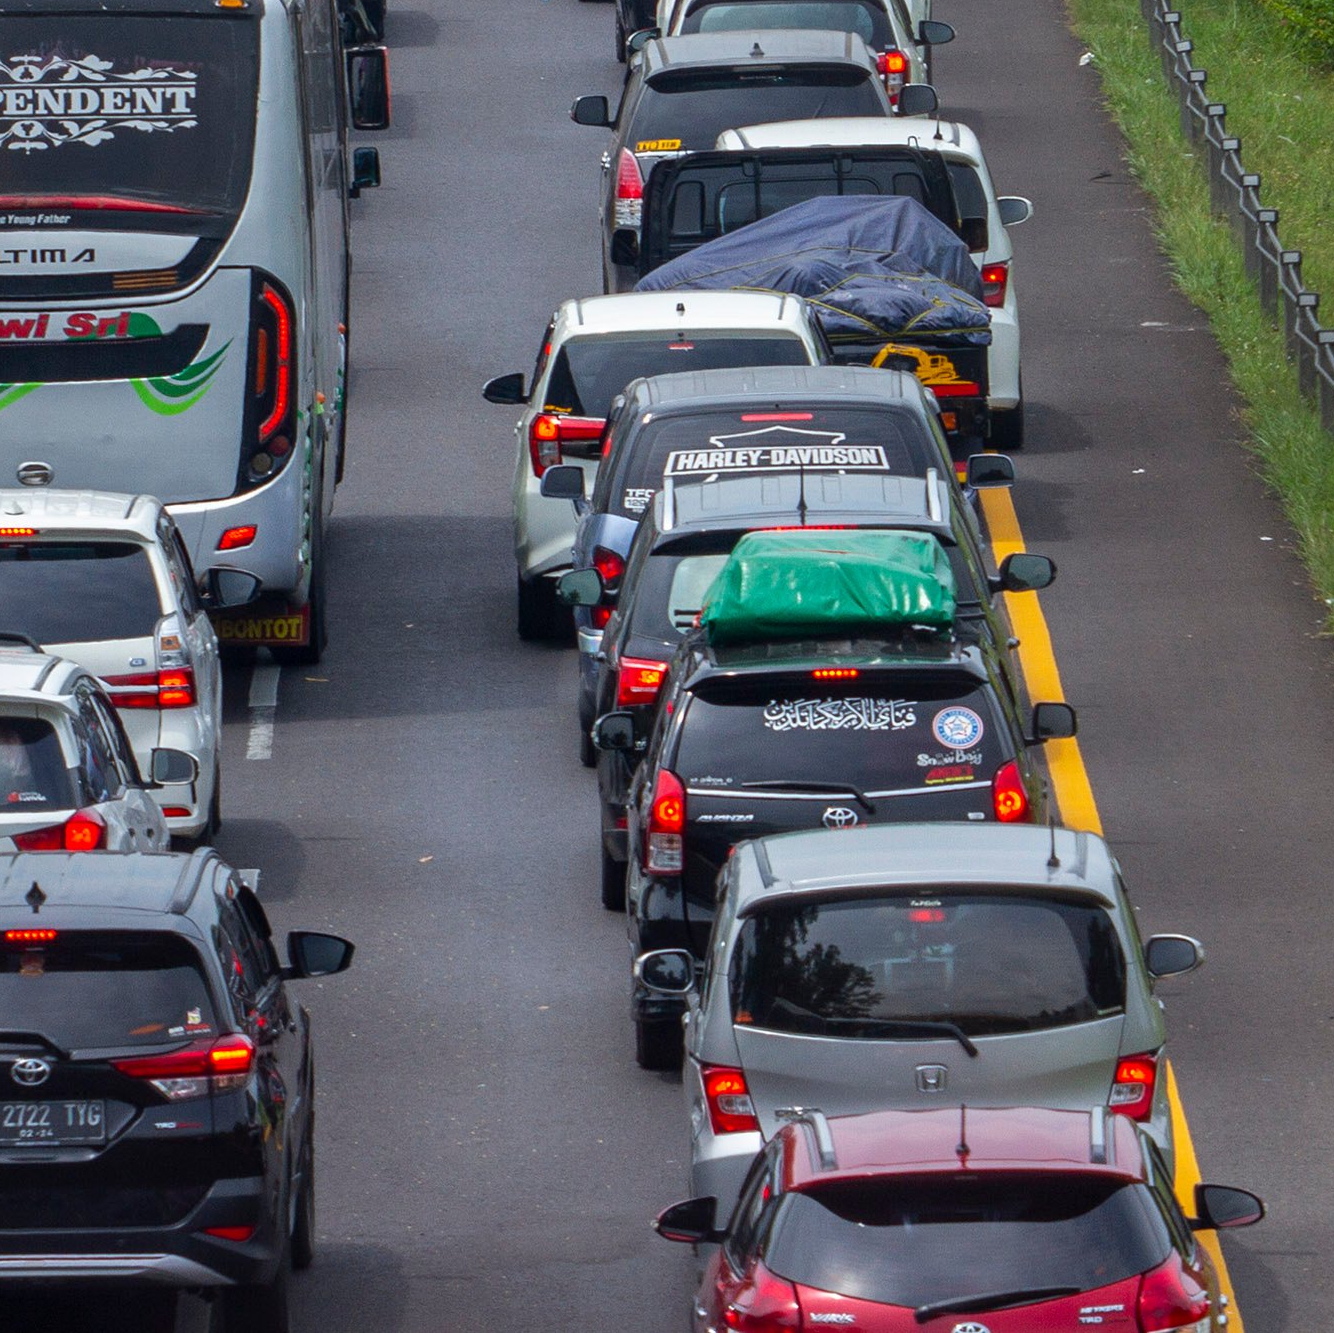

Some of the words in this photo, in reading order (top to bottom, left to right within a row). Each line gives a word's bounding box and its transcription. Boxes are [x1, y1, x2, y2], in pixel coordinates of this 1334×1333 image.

[8, 214, 36, 227] Young
[37, 213, 71, 225] Father
[675, 447, 879, 471] HARLEY-DAVIDSON
[2, 1104, 51, 1128] 2722
[65, 1103, 102, 1126] TYG
